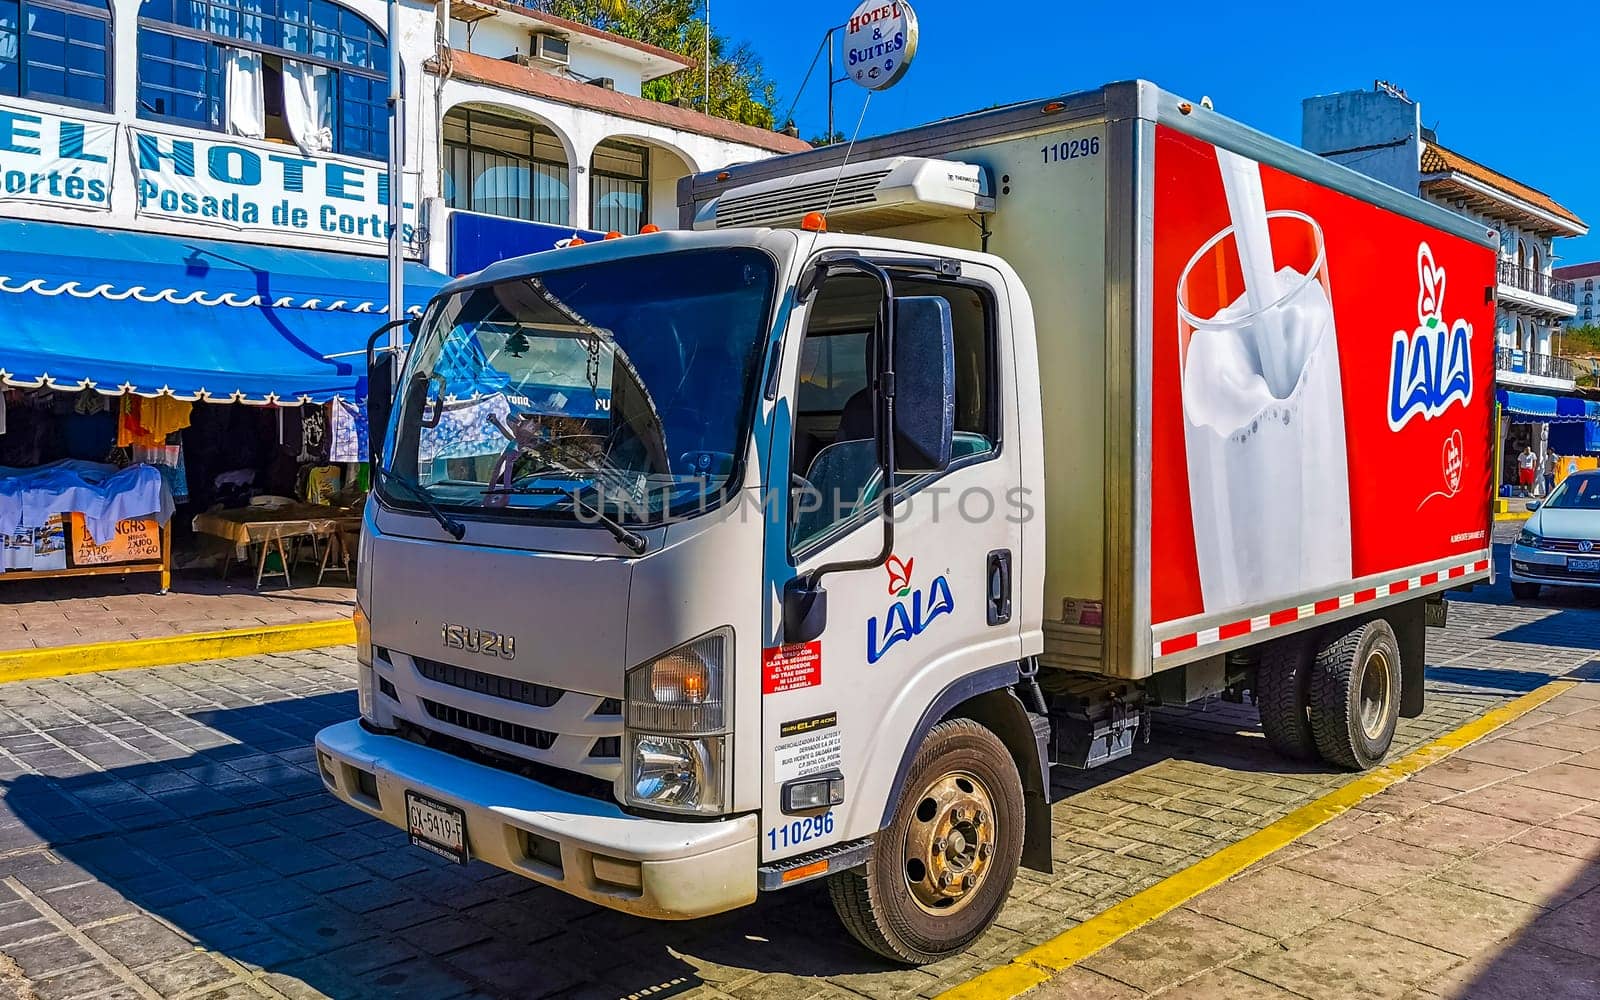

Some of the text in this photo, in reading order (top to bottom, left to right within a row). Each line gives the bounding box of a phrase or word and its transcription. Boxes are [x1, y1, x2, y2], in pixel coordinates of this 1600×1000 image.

[849, 2, 901, 34] HOTEL
[872, 27, 882, 40] &
[849, 32, 903, 65] SUITES
[1041, 136, 1099, 163] 110296
[0, 164, 105, 203] ortés
[137, 132, 414, 209] HOTEL
[138, 178, 414, 243] Posada de Corts
[1389, 325, 1472, 425] LALA
[868, 575, 954, 664] LALA
[441, 622, 515, 660] ISUZU
[789, 654, 819, 664] SEGURIDAD
[783, 662, 811, 671] VENDEDOR
[767, 811, 834, 850] 110296
